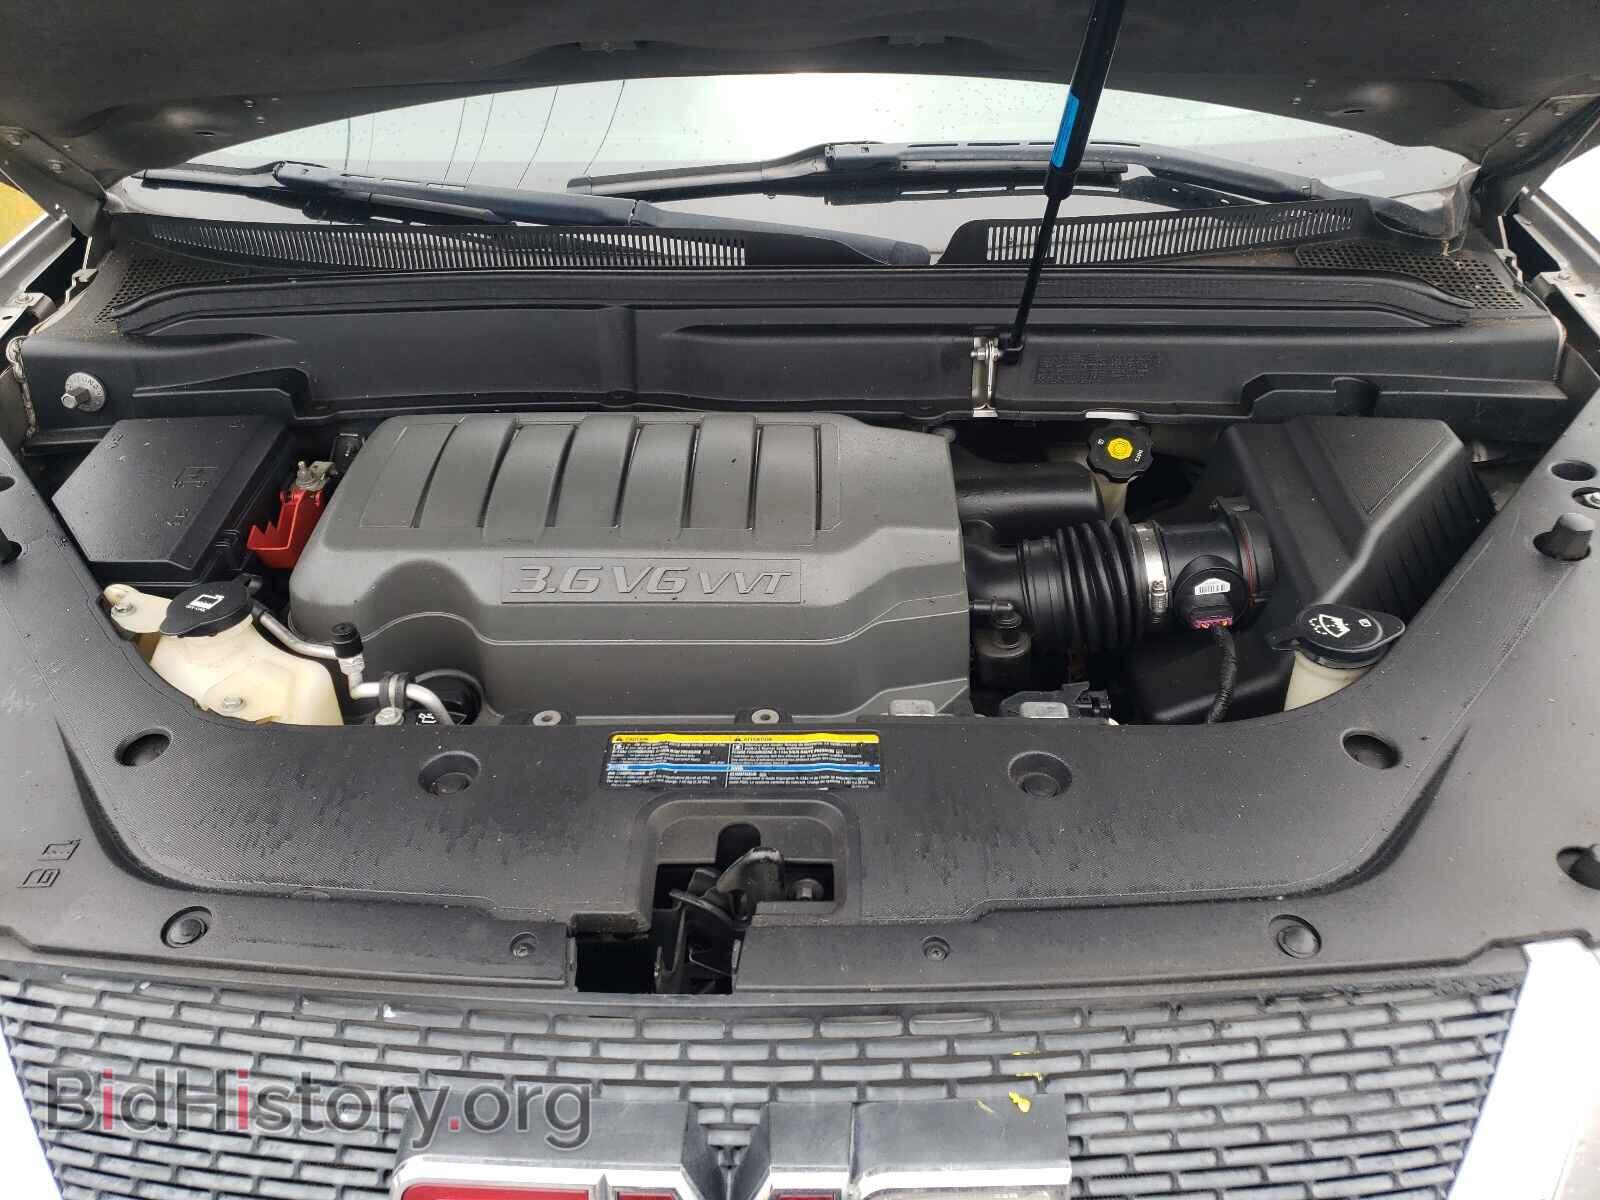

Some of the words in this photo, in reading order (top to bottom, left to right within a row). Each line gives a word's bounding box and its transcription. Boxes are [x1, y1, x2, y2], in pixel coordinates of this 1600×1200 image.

[509, 566, 603, 594] 3.6
[611, 566, 690, 594] V6
[698, 570, 792, 594] VVT
